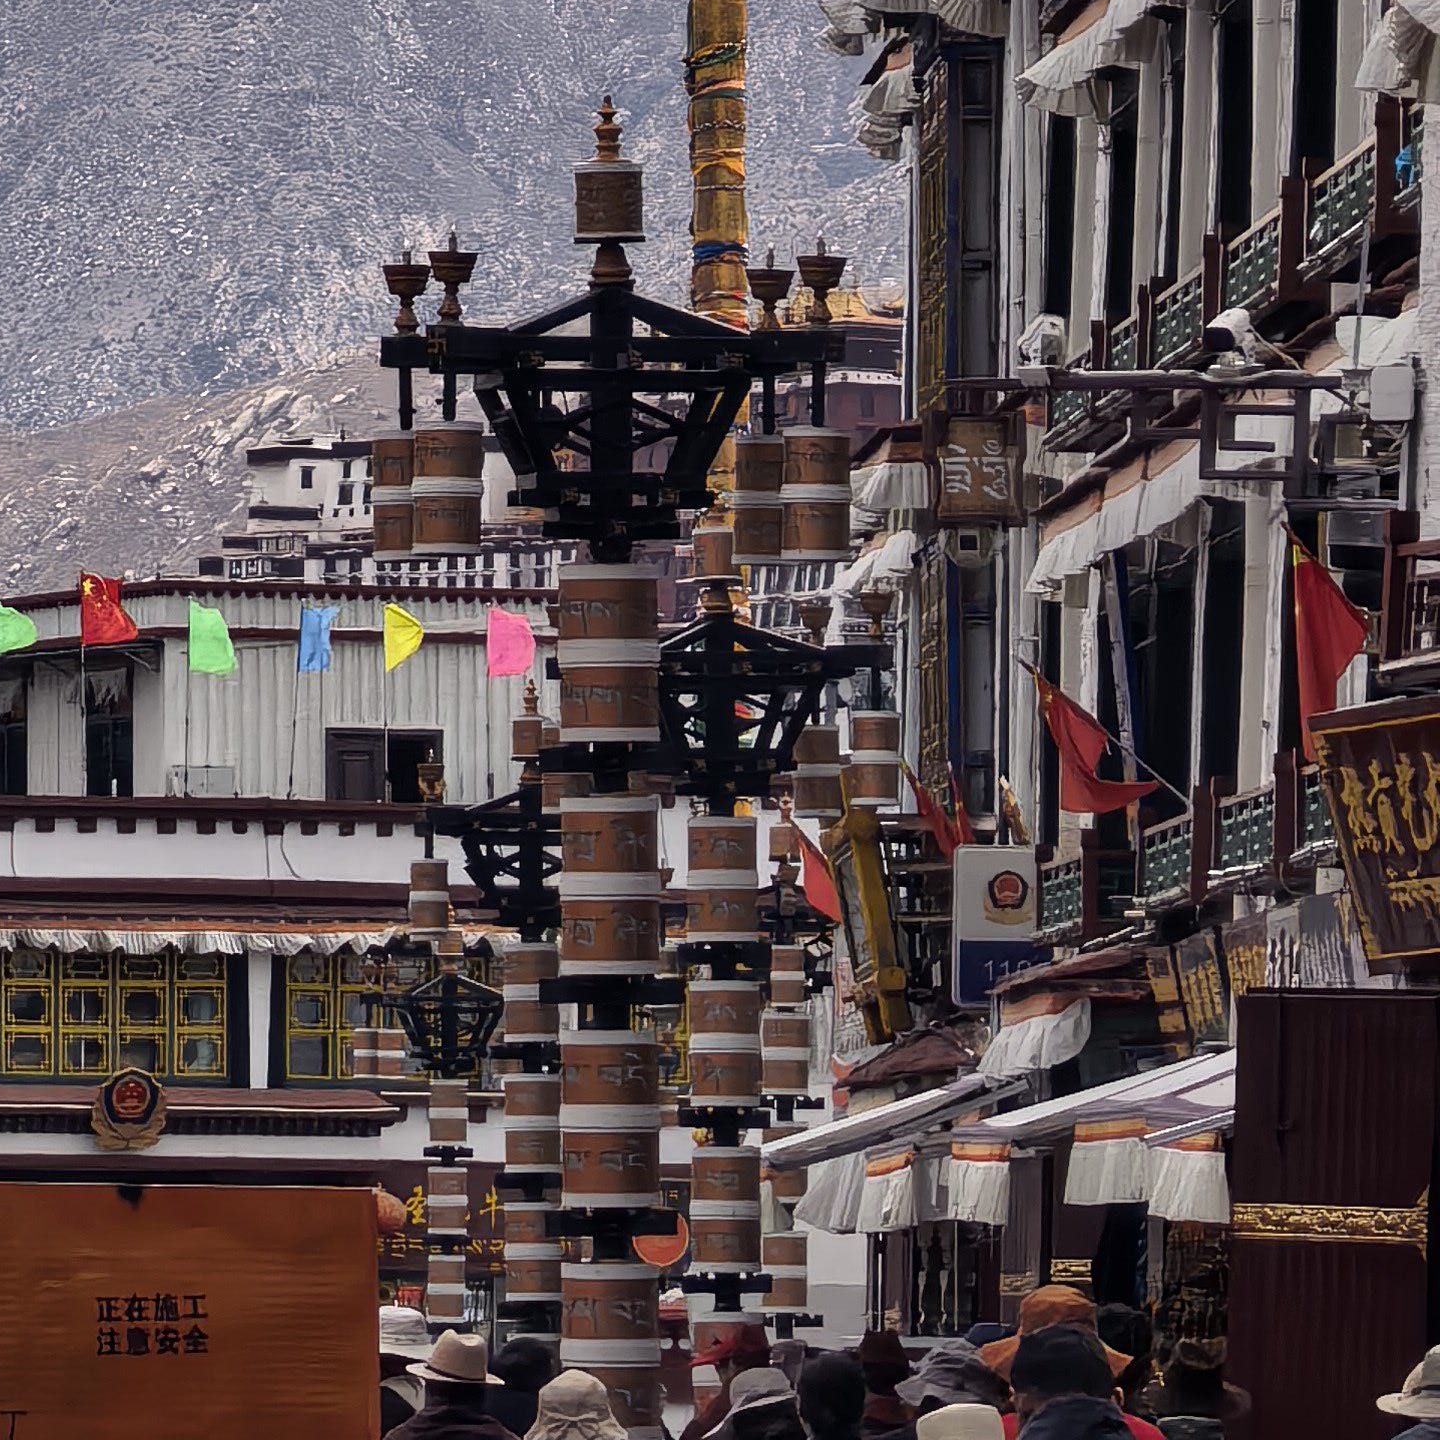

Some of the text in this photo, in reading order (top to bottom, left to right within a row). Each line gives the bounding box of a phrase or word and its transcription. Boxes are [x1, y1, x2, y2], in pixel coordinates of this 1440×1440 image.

[95, 1292, 208, 1322] 正在施工
[96, 1324, 209, 1356] 注意安全
